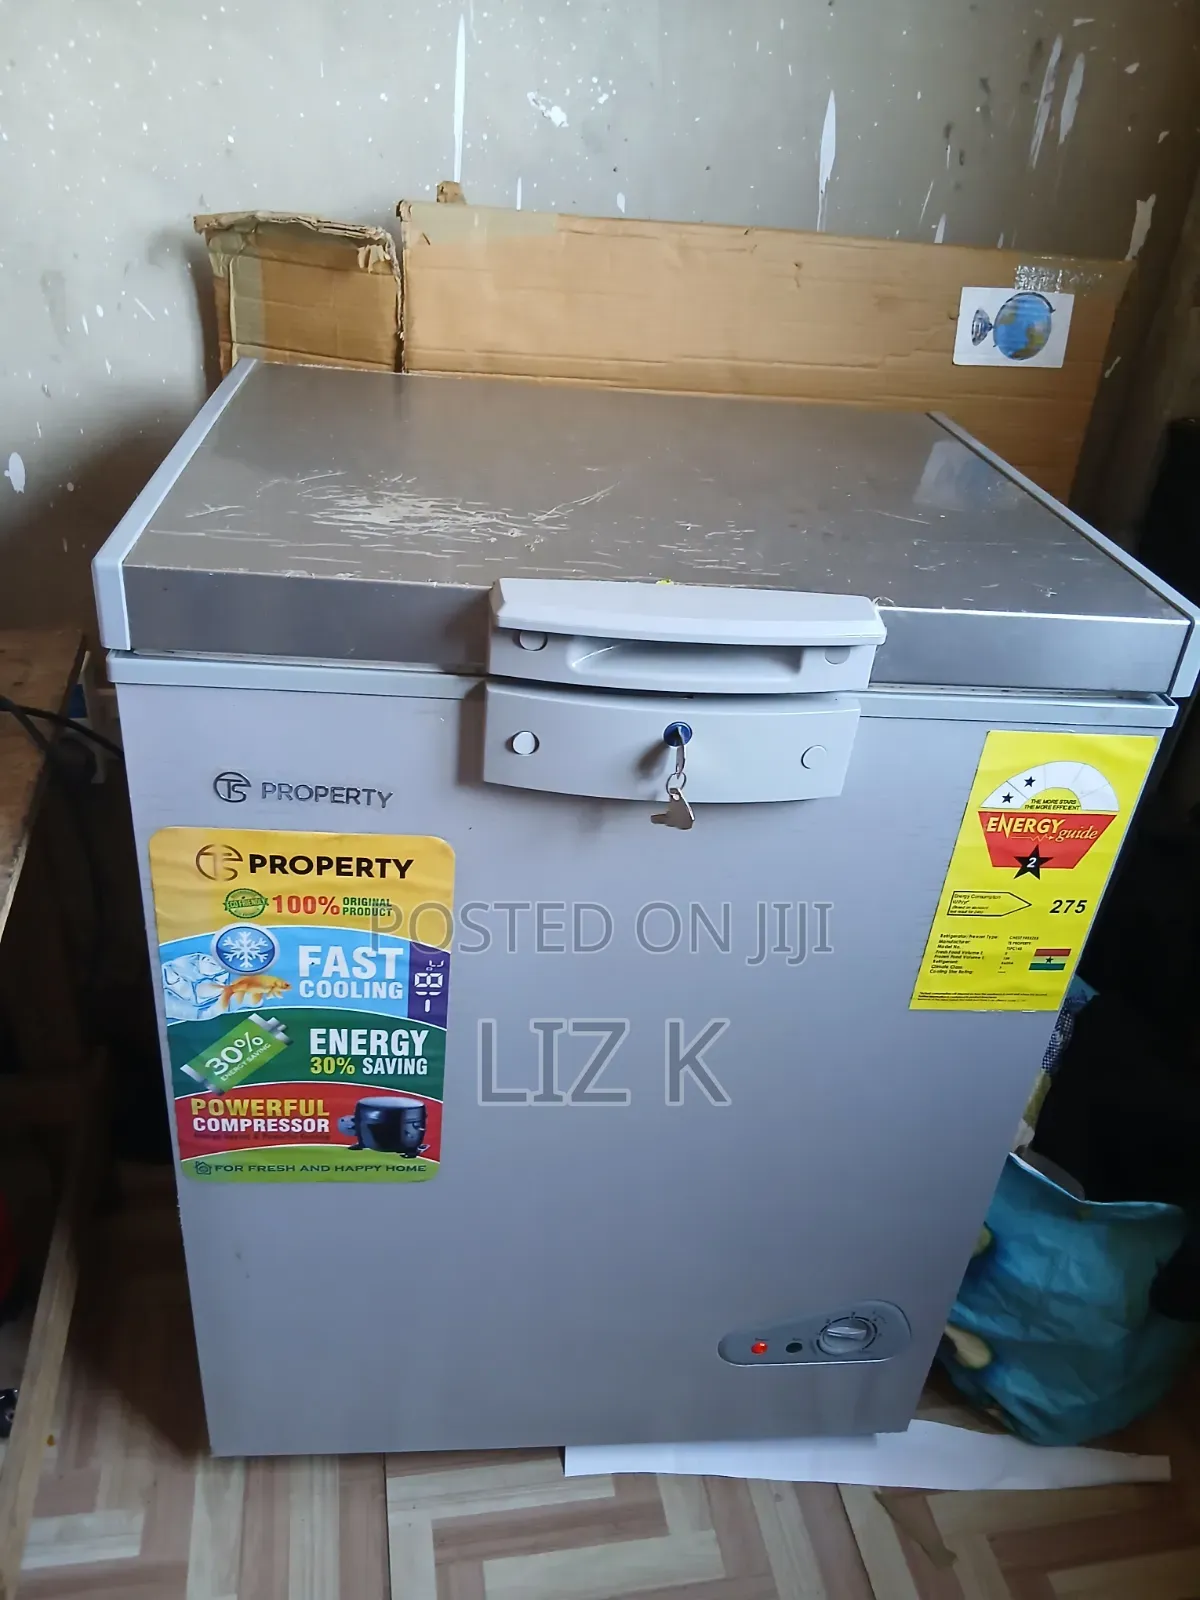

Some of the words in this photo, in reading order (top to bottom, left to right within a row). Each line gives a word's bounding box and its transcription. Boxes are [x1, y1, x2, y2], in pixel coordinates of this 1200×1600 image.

[261, 781, 394, 809] PROPERTY
[986, 812, 1066, 839] ENERGY
[1055, 826, 1098, 842] guide
[249, 853, 415, 879] PROPERTY
[1026, 857, 1037, 868] 2
[272, 895, 340, 916] 100%
[342, 896, 392, 908] ORIGINAL
[1049, 899, 1087, 914] 275
[342, 907, 393, 917] PRODUCT
[298, 945, 404, 980] FAST
[299, 980, 403, 999] COOLING
[310, 1028, 429, 1056] ENERGY
[205, 1032, 264, 1076] 30%
[220, 1061, 248, 1081] ENERGY
[246, 1043, 272, 1062] SAVING
[310, 1056, 355, 1075] 30%
[362, 1058, 428, 1075] SAVING
[191, 1098, 330, 1117] POWERFUL
[192, 1117, 330, 1133] COMPRESSOR
[215, 1164, 244, 1172] FOR
